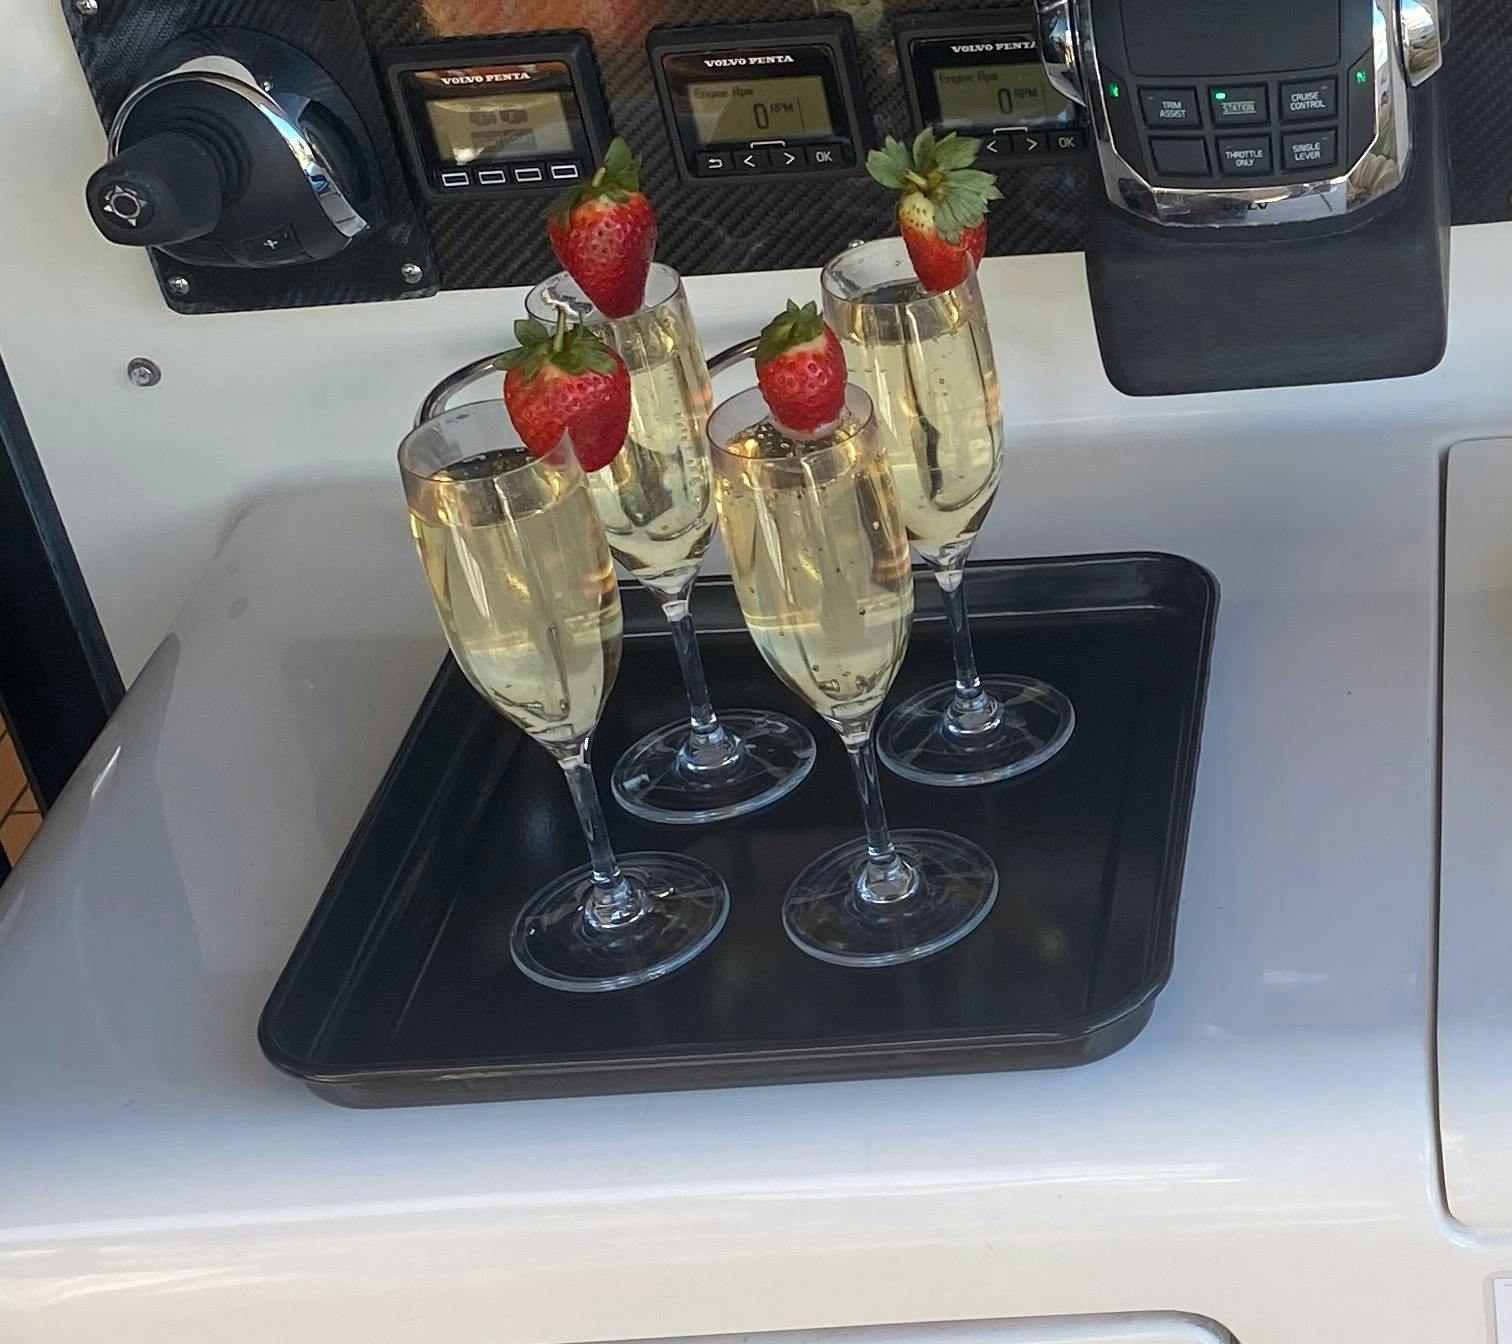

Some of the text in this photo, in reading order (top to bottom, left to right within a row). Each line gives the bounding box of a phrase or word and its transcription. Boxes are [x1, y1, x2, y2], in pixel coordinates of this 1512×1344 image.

[950, 43, 993, 53] VOLVO
[704, 55, 794, 67] VOLVO PENTA
[441, 72, 531, 85] VOLVO PENTA
[998, 87, 1038, 114] 0 RPM
[1291, 91, 1319, 102] CRUISE
[1162, 100, 1182, 110] TRIM
[1222, 104, 1255, 113] STATION
[1289, 100, 1326, 111] CONTROL
[753, 102, 769, 130] 0
[1159, 108, 1186, 119] ASSIST
[1058, 136, 1075, 148] OK
[1292, 142, 1321, 152] SINGLE
[816, 151, 833, 163] OK
[1225, 149, 1263, 160] THROTTLE
[1295, 150, 1321, 161] LEVER
[1235, 158, 1254, 167] ONLY
